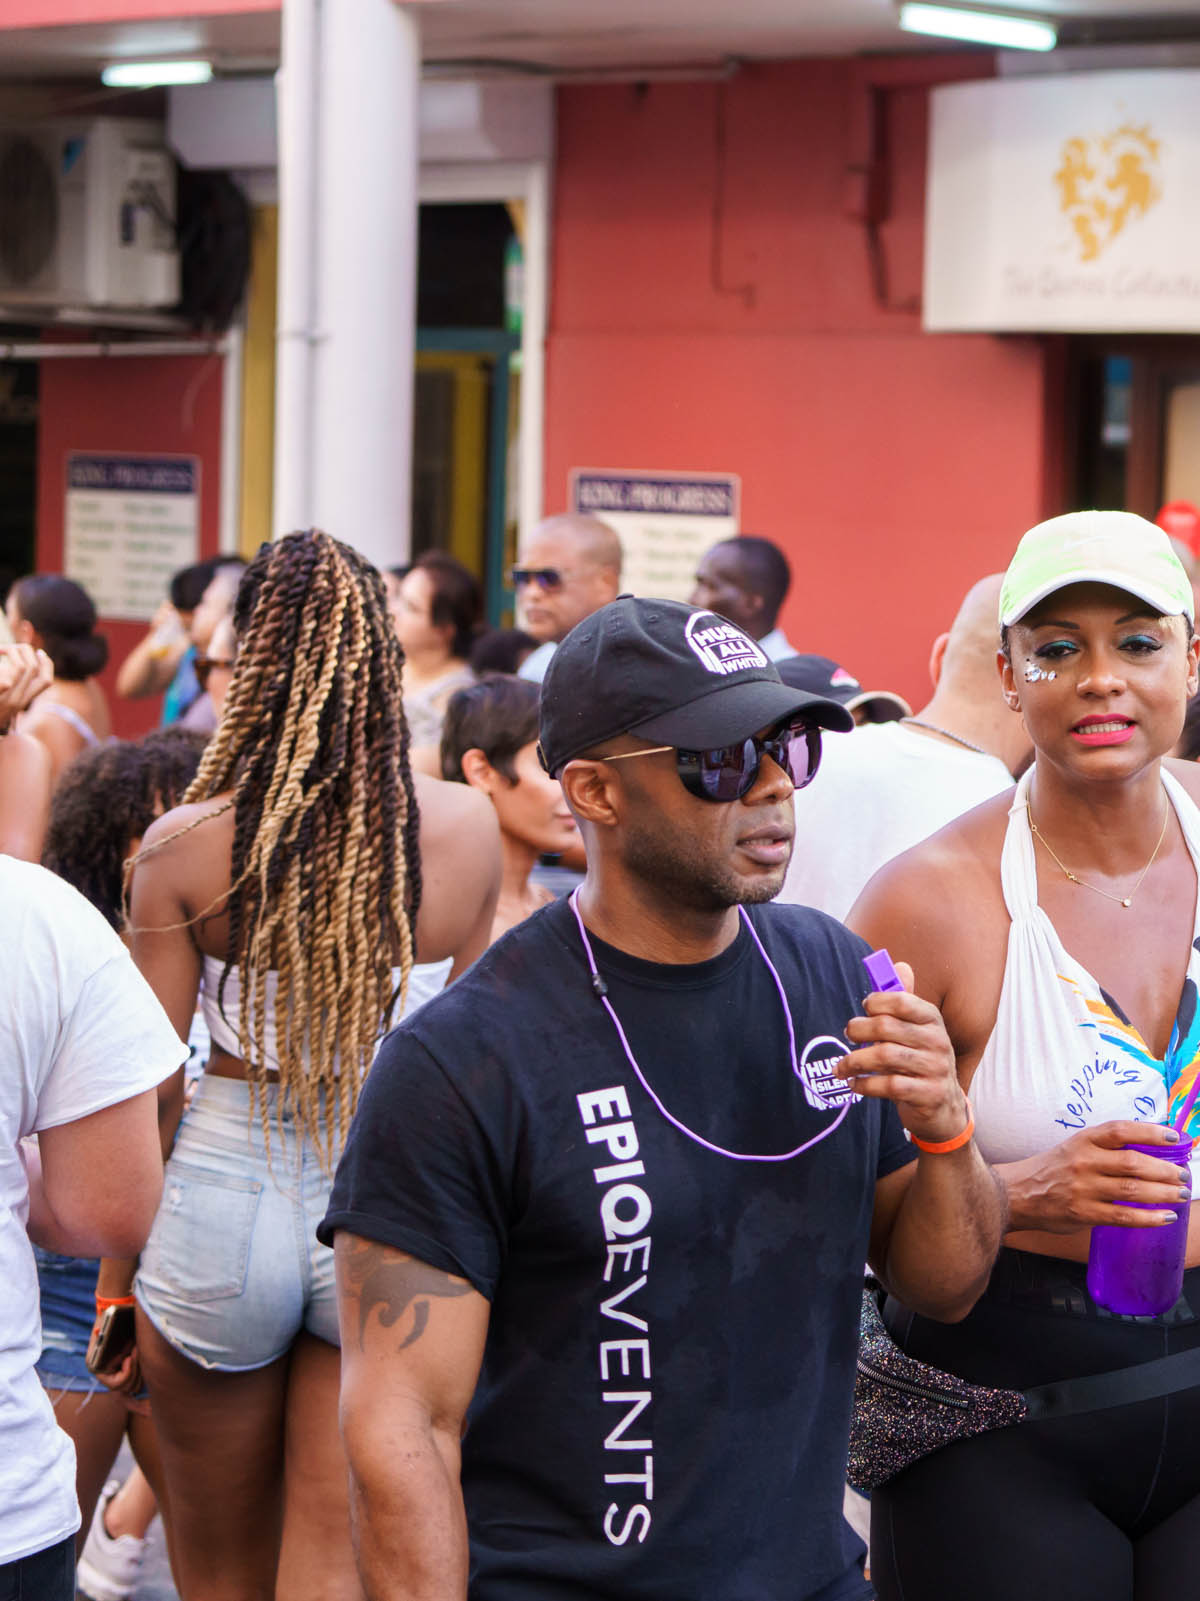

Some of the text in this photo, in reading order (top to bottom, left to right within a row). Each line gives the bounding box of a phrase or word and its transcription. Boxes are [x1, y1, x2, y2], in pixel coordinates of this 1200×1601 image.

[719, 639, 752, 658] ALL
[805, 1055, 844, 1079] HUS
[817, 1077, 854, 1093] SILEN
[1054, 1051, 1143, 1130] tepping
